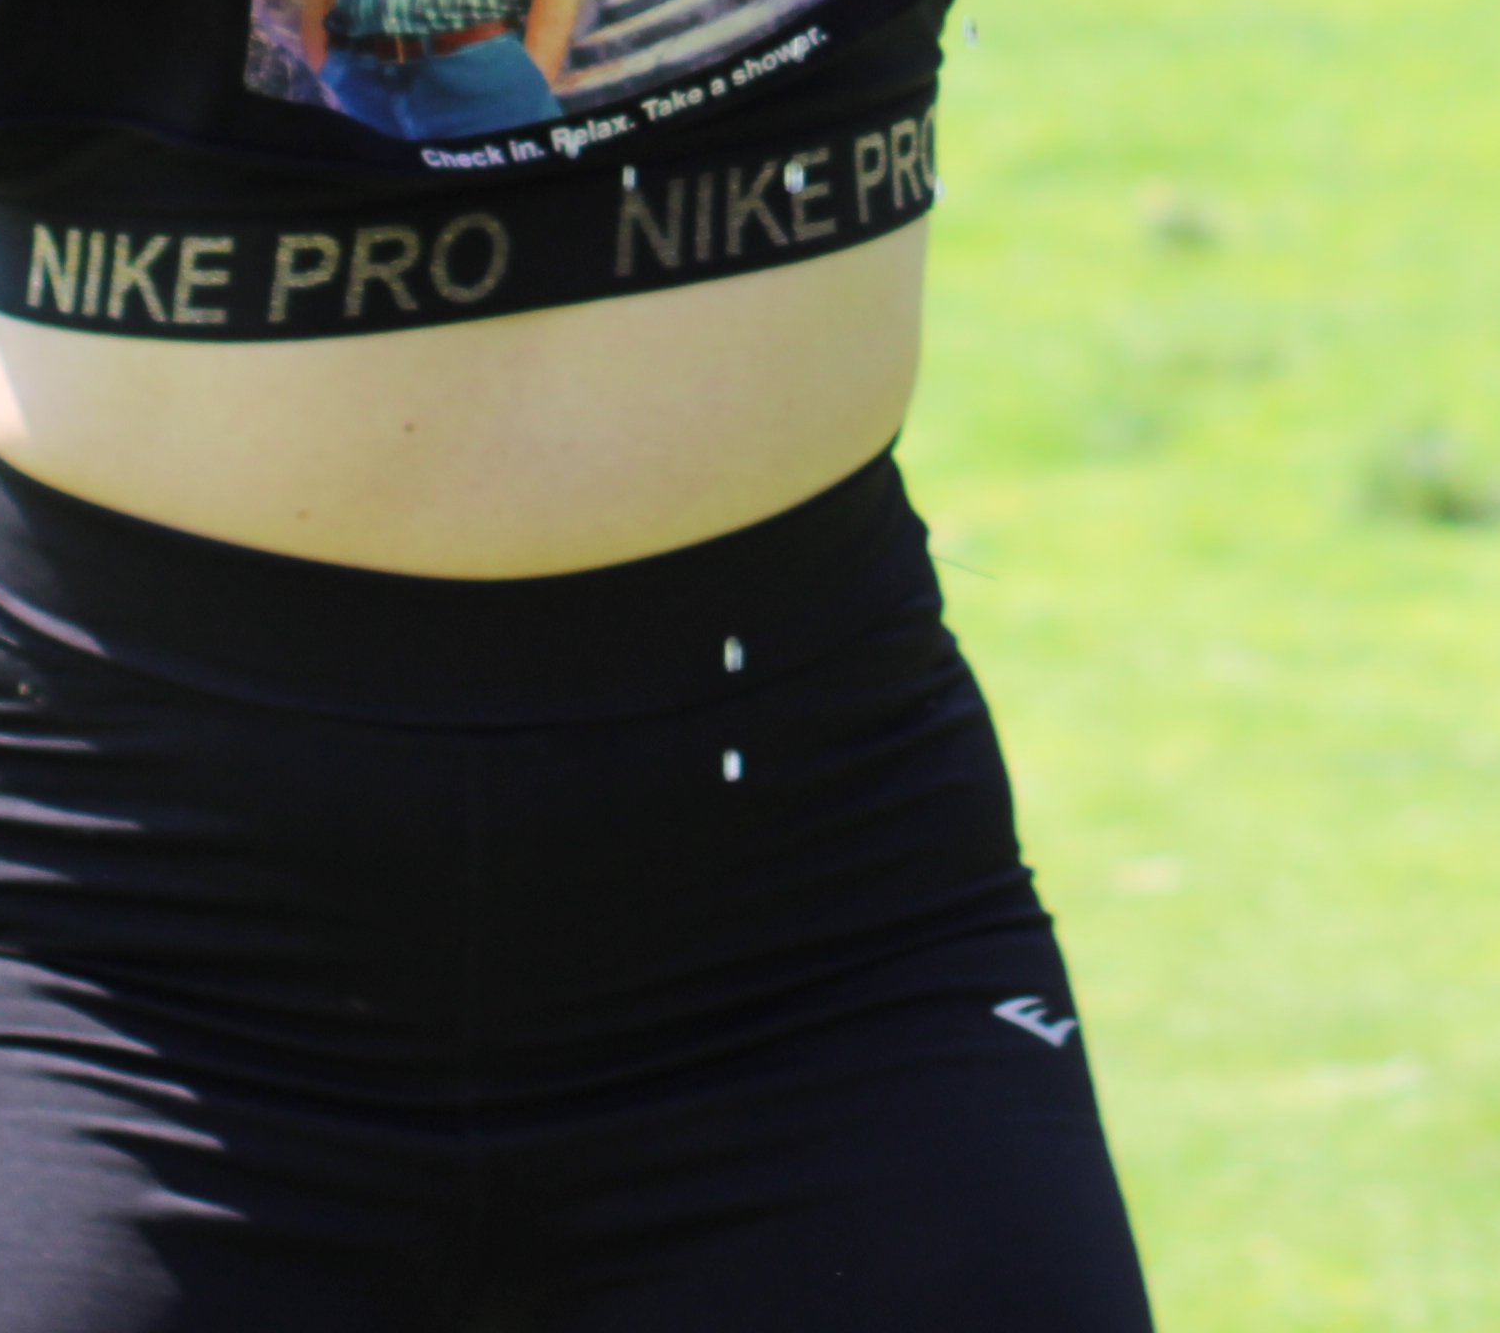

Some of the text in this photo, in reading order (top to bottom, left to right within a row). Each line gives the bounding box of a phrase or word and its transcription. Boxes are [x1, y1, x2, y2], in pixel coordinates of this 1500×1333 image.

[420, 26, 828, 169] Check in. Relax. Take a shower.
[26, 223, 234, 325] NIKE
[267, 212, 509, 323] PRO
[614, 147, 837, 278] NIKE
